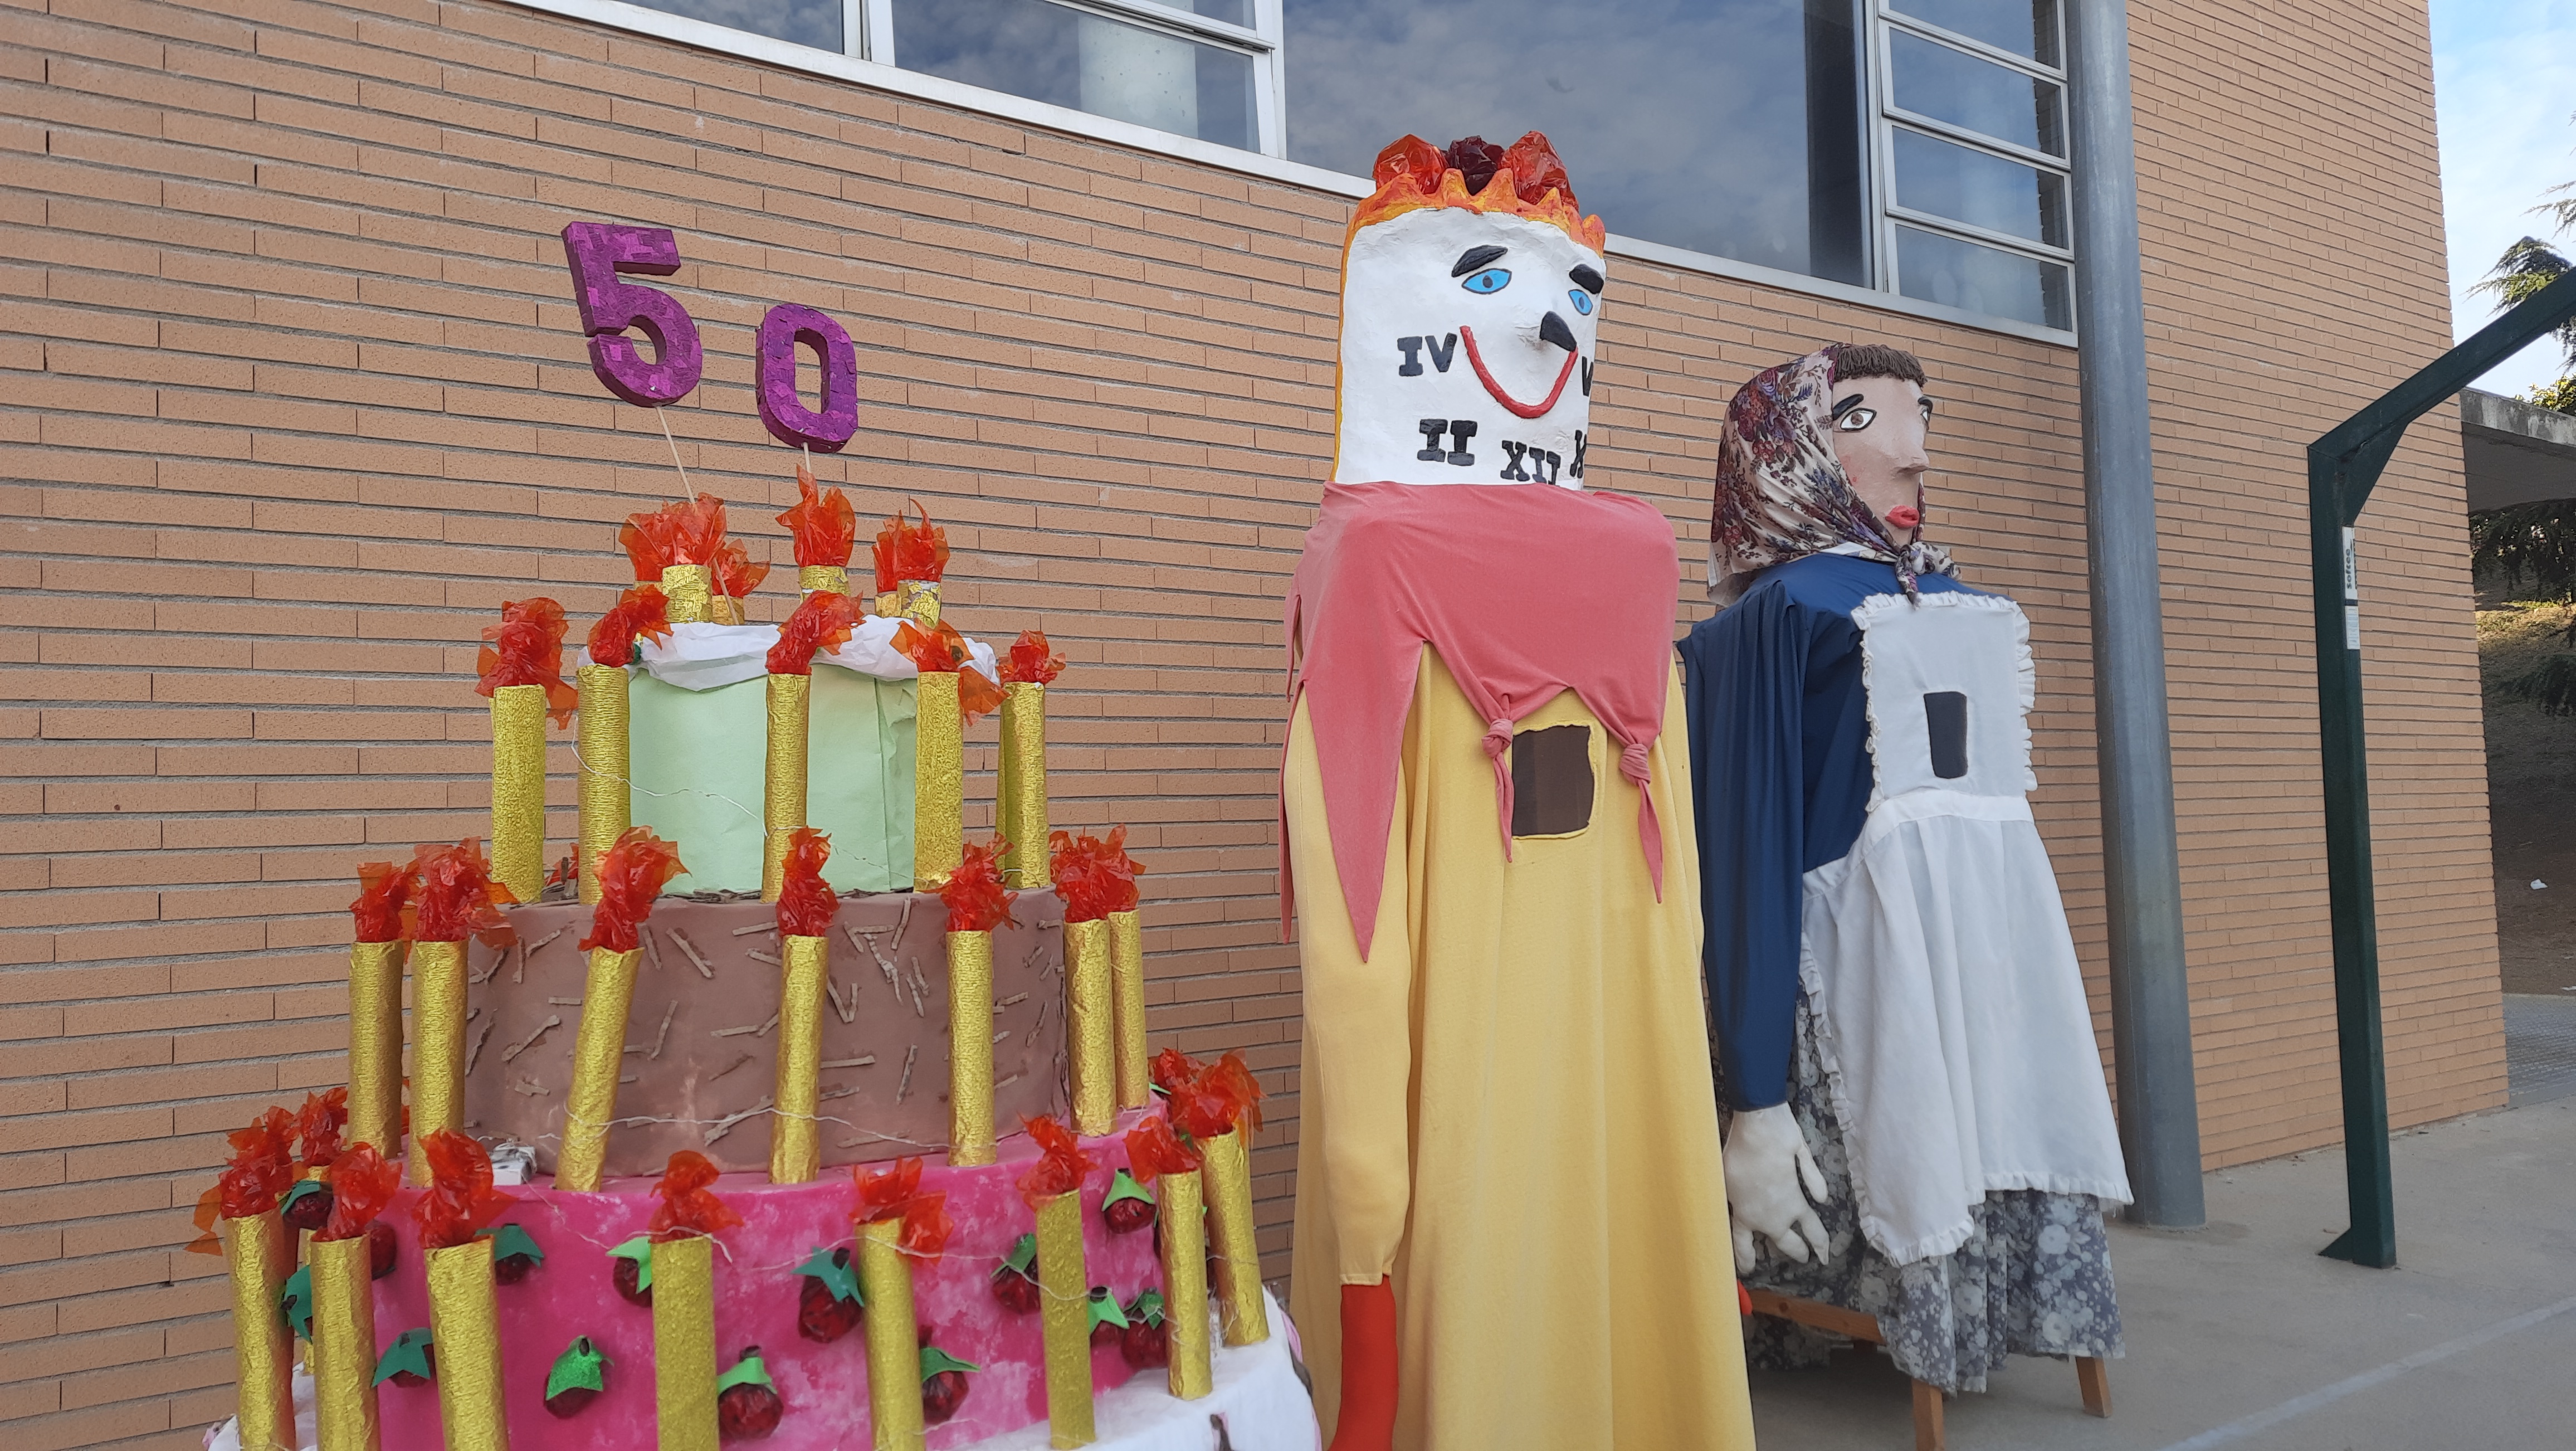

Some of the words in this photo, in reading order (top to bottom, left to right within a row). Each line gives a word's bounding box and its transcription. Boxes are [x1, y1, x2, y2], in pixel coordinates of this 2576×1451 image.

[561, 221, 858, 454] 50
[1397, 333, 1457, 377] IV
[1417, 418, 1477, 466] II
[1500, 440, 1561, 485] XII
